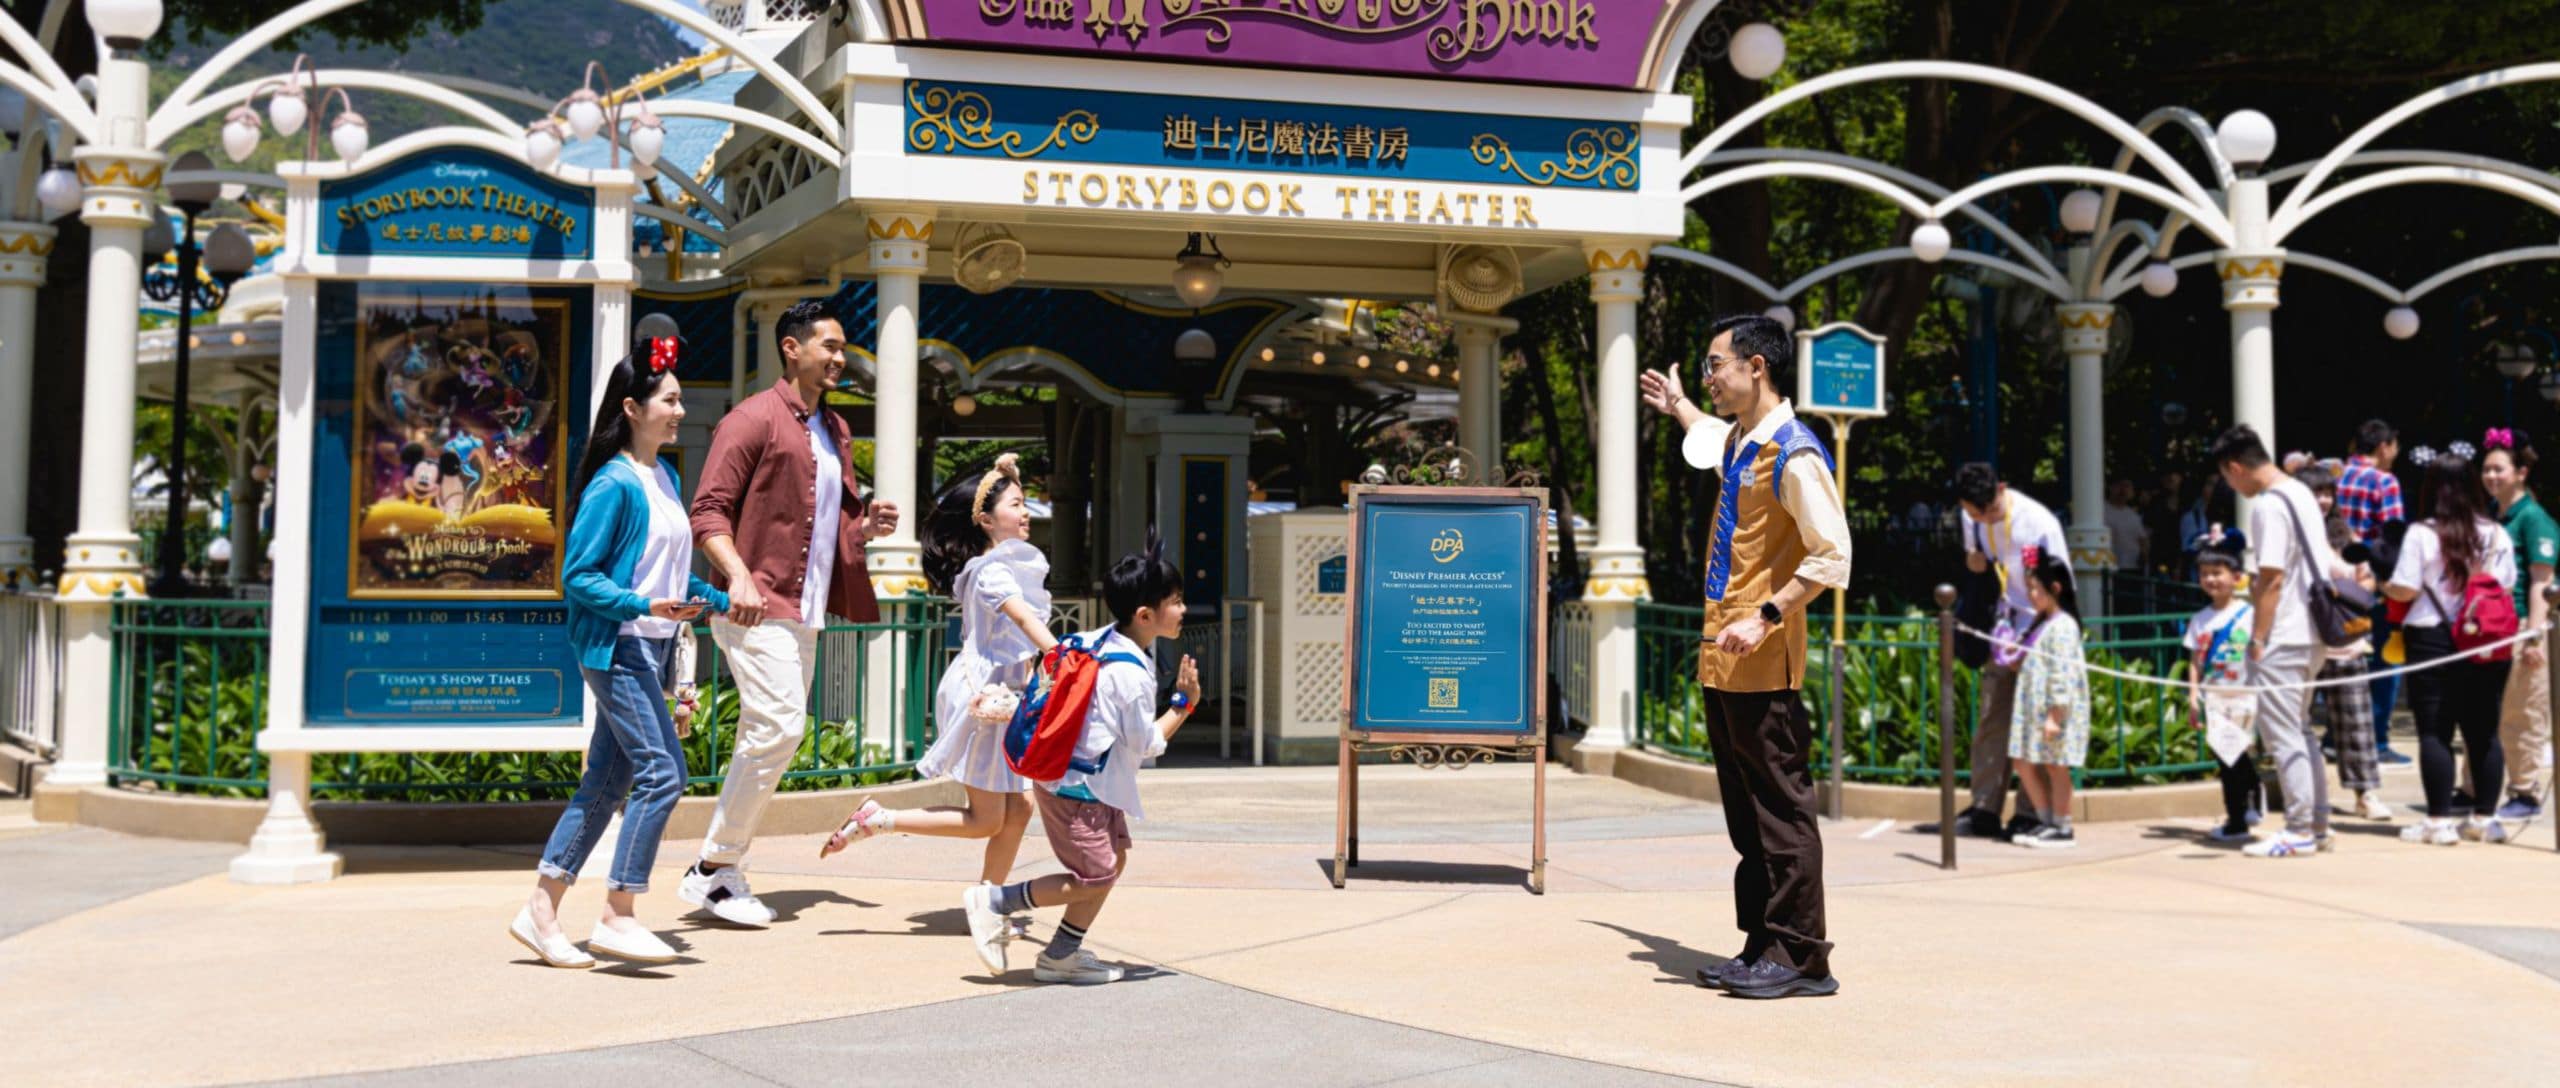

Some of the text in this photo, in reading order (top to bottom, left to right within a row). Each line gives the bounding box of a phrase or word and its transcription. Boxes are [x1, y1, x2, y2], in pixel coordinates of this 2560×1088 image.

[1163, 112, 1409, 162] 迪士尼魔法書房
[1023, 169, 1539, 225] STORYBOOK THEATER
[336, 184, 577, 238] STORYBOOK THEATER
[1430, 537, 1464, 553] DPA
[1427, 571, 1467, 581] PREMIER
[464, 611, 506, 624] 15:45
[522, 611, 563, 624] 17:15
[440, 674, 485, 685] SHOW
[488, 674, 532, 685] TIMES
